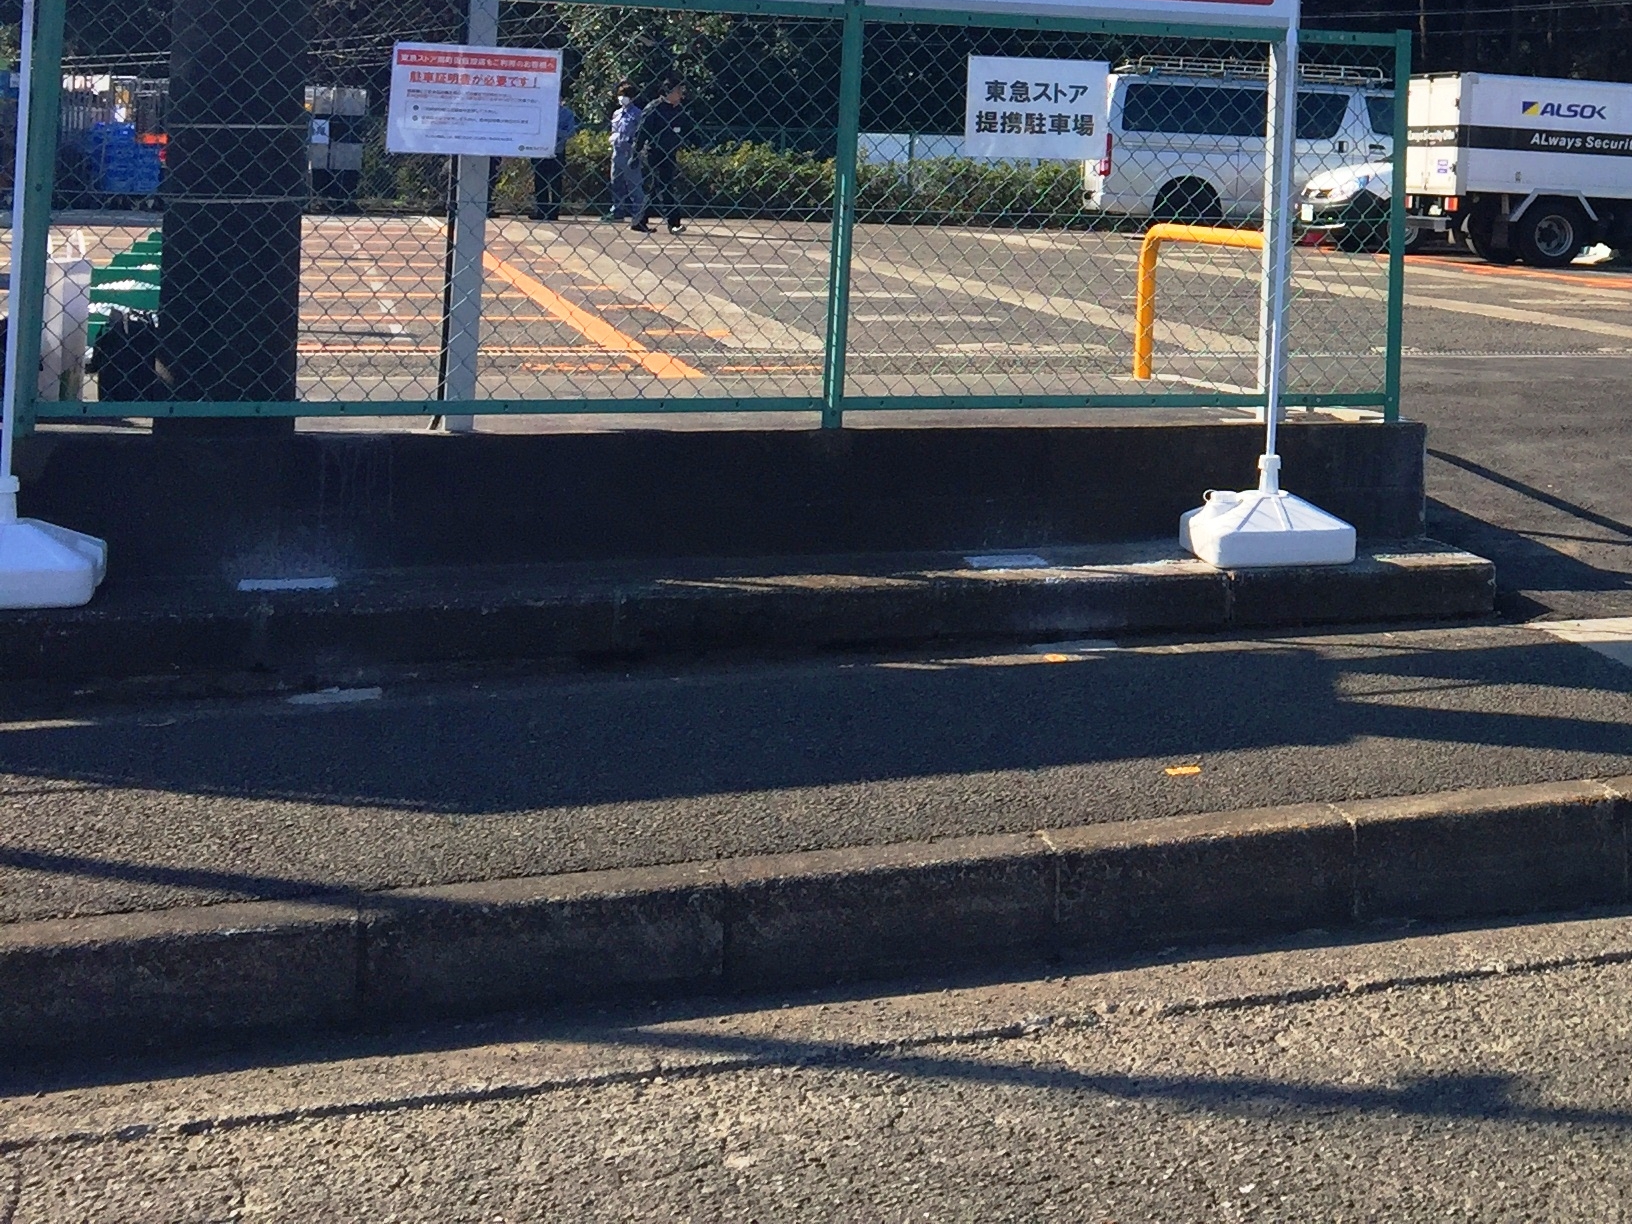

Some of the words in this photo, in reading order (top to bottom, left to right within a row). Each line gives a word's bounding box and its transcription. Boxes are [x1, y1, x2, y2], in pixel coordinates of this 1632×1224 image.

[984, 79, 1089, 104] 東急ストア
[975, 110, 1095, 137] 提携駐車場
[1540, 102, 1607, 120] ALSOK
